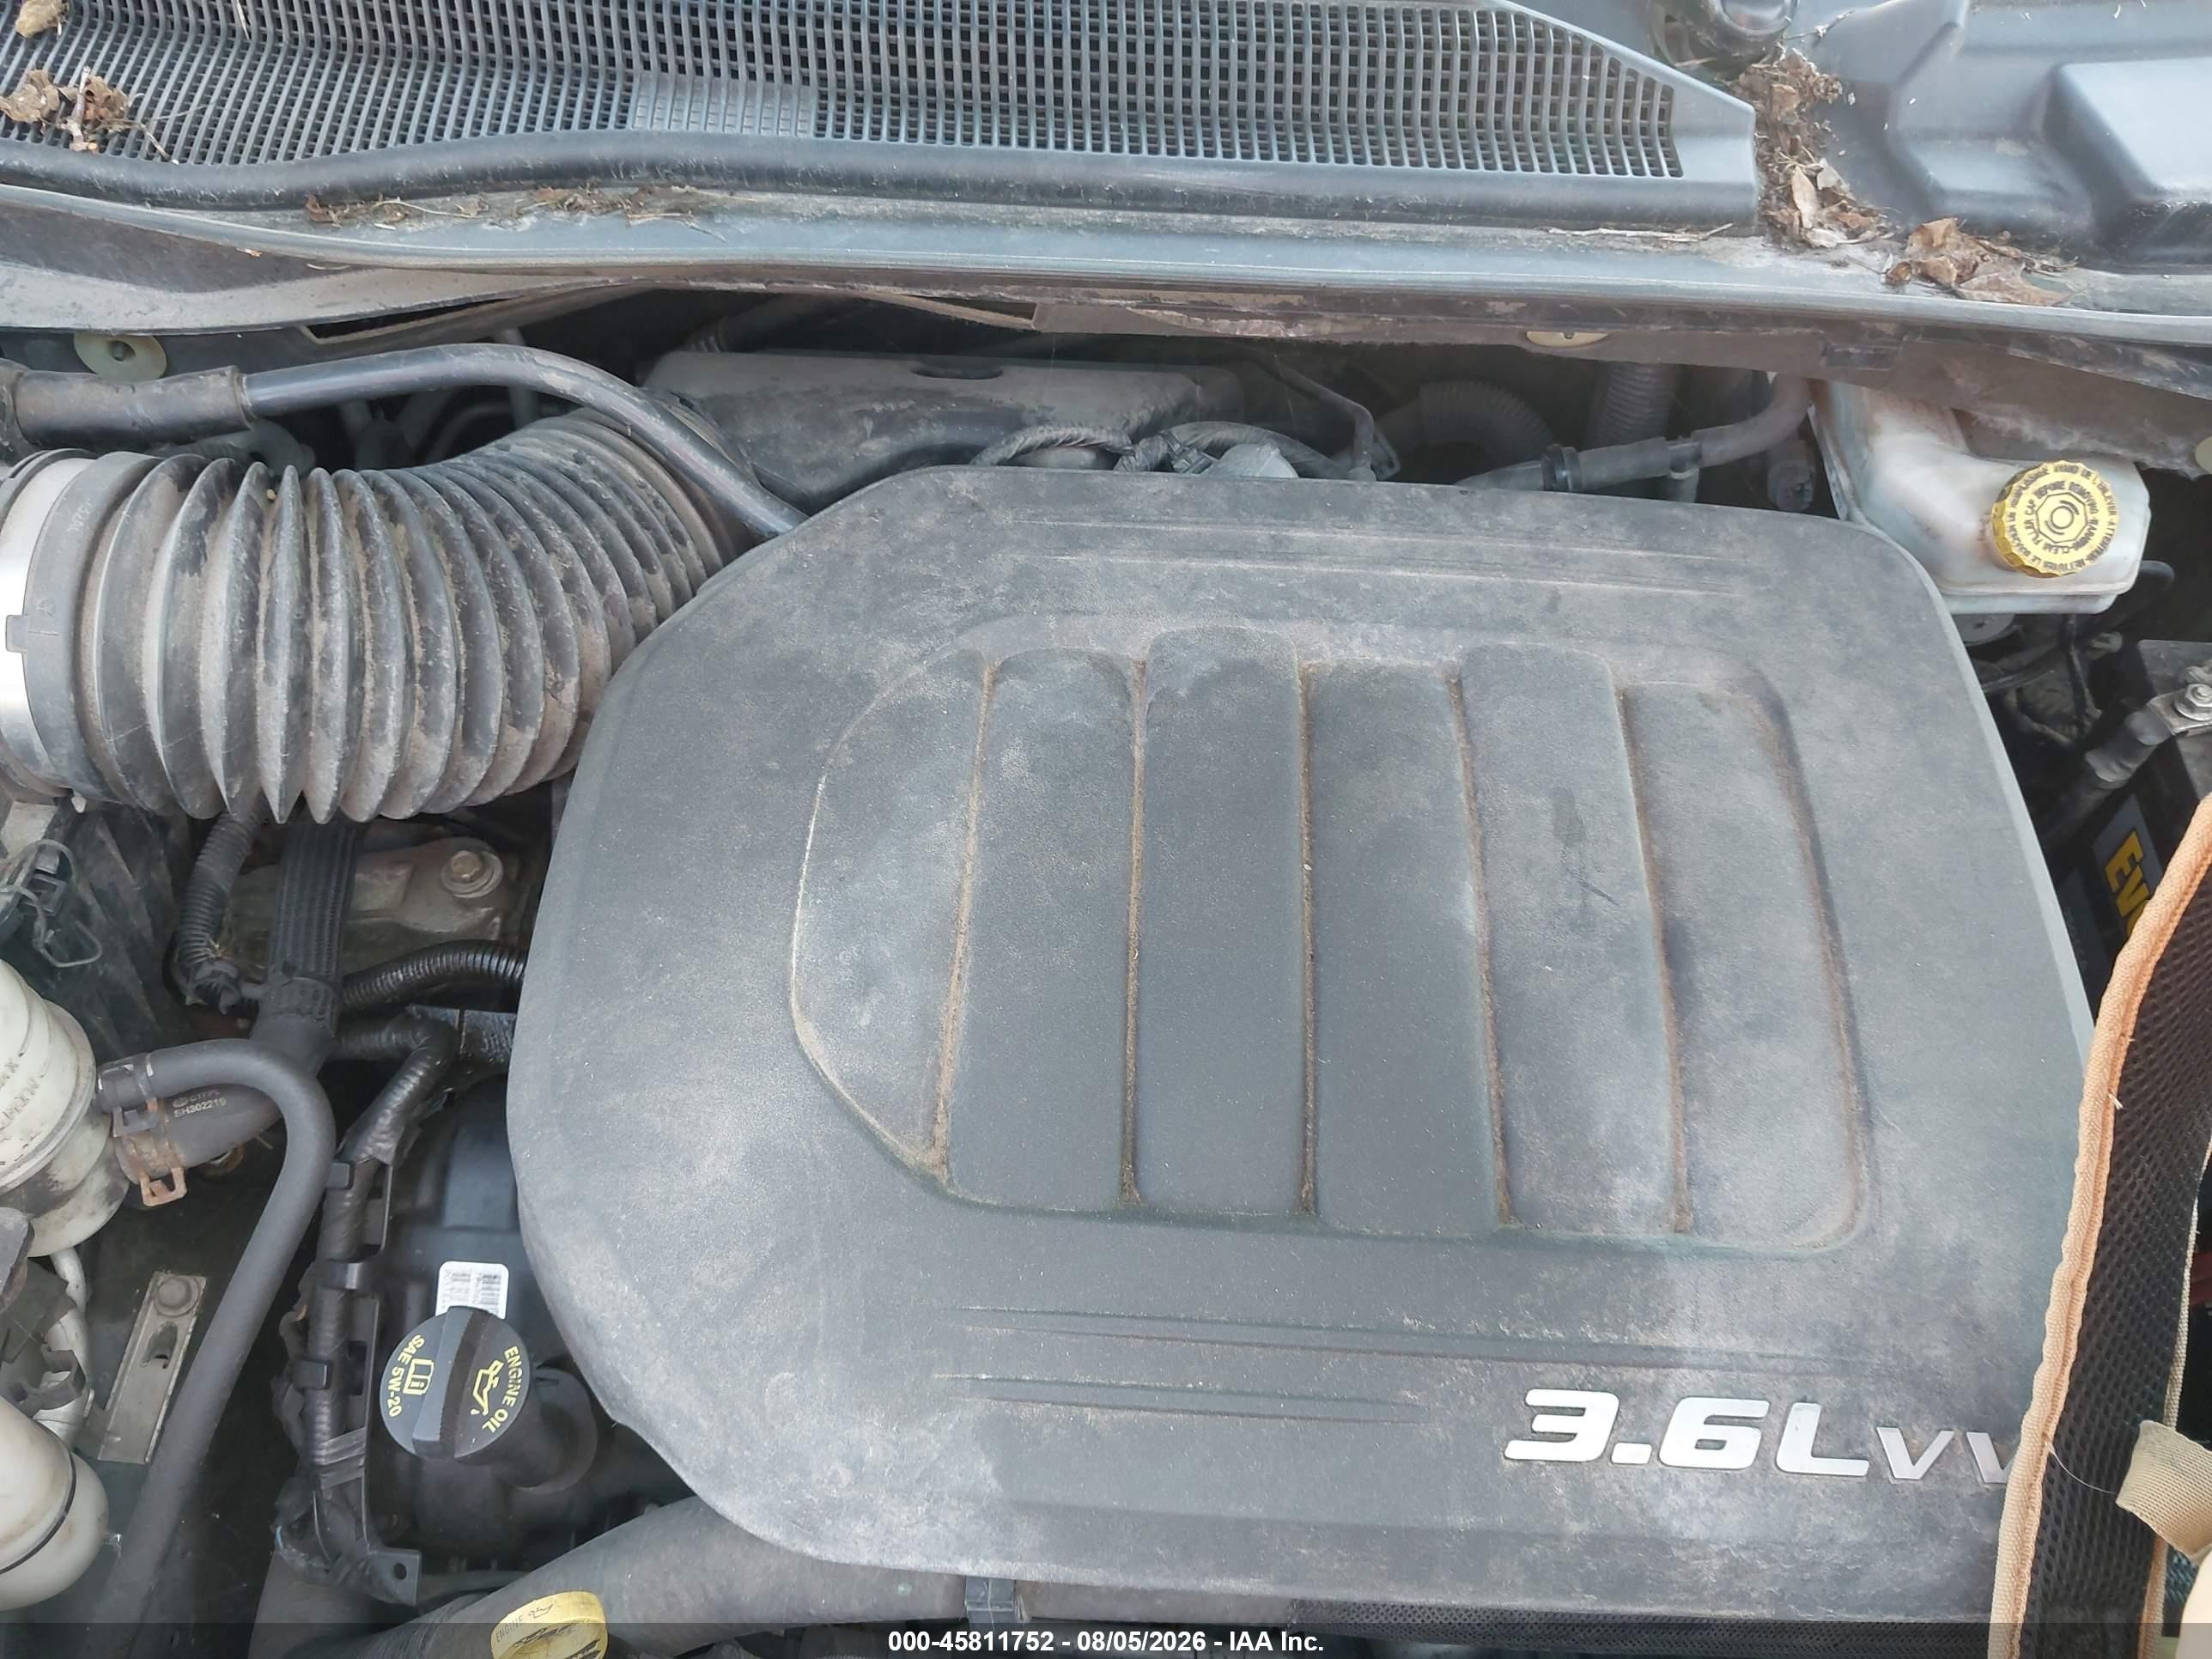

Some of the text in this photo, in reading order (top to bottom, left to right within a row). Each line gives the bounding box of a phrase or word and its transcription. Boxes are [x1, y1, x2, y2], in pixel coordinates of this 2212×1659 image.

[2105, 830, 2151, 937] EV
[386, 1334, 425, 1417] SAE 5W-20
[482, 1346, 523, 1433] ENGINE OIL
[1504, 1388, 1869, 1477] 3.6L
[495, 1614, 523, 1643] ENGINE
